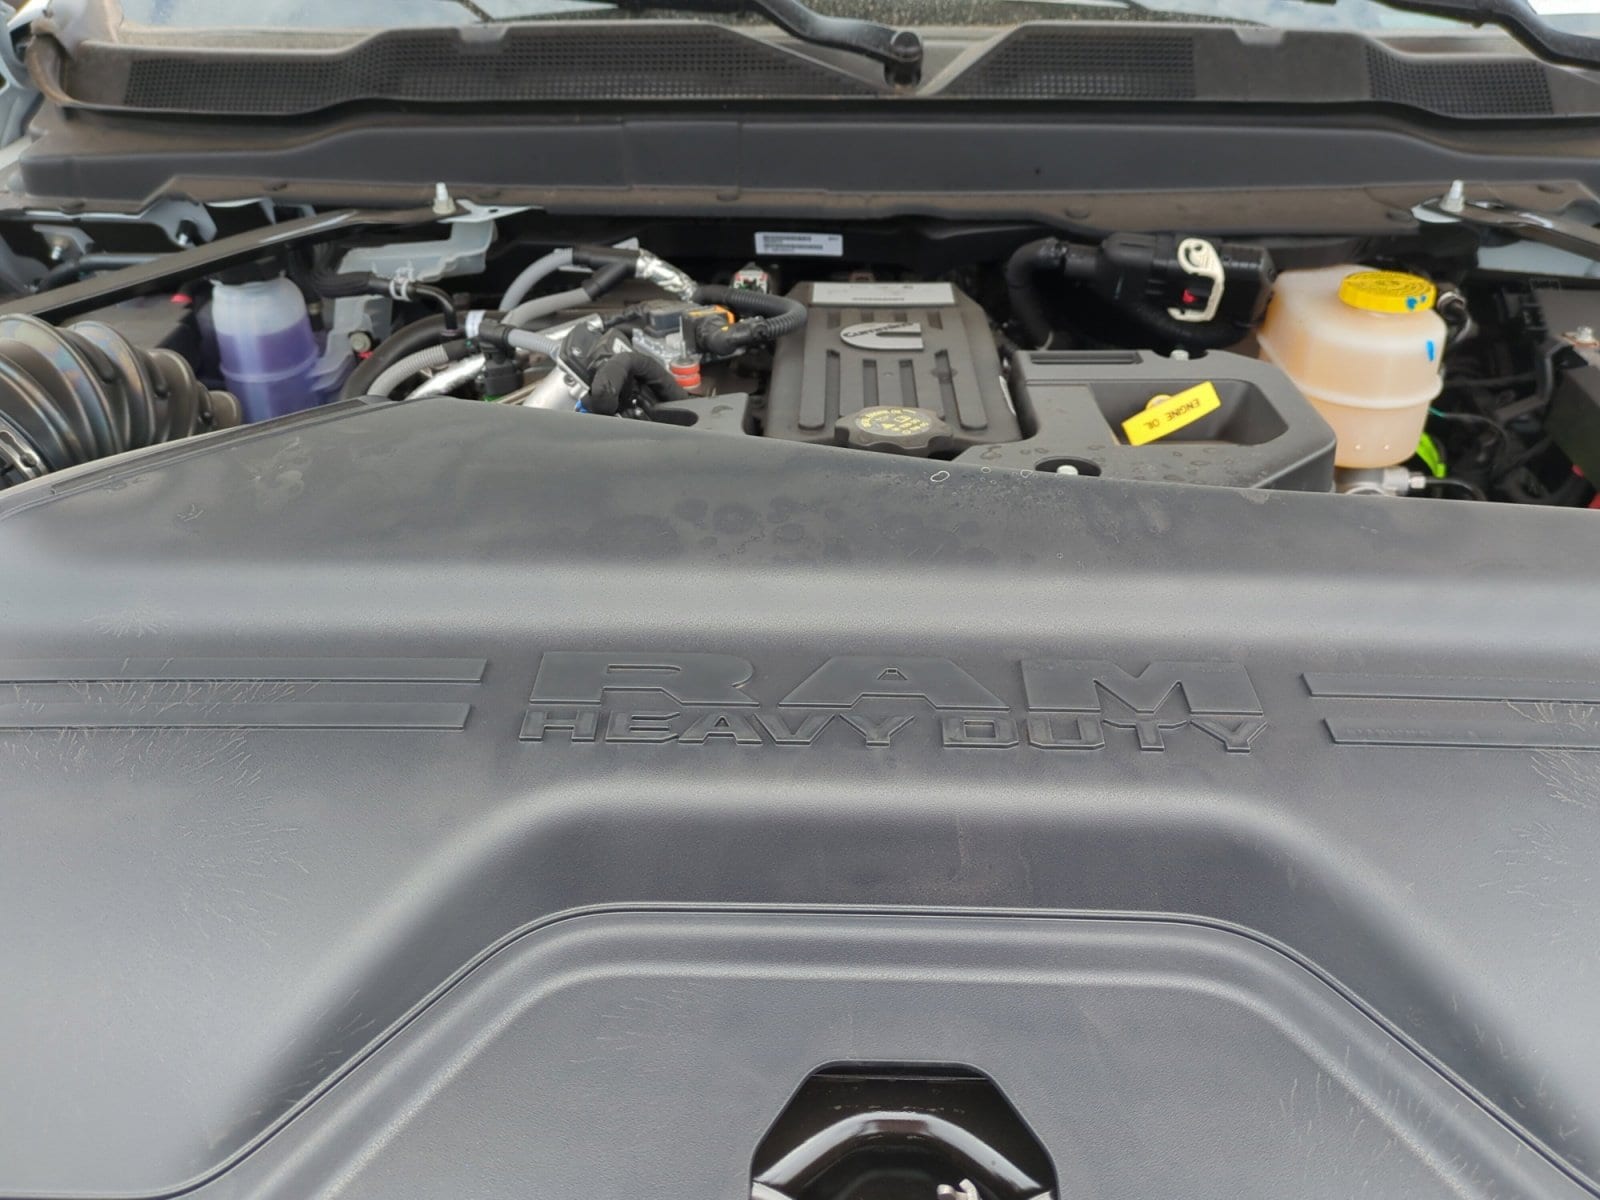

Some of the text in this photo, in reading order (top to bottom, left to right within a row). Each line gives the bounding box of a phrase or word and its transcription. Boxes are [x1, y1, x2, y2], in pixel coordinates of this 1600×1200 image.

[1143, 398, 1200, 430] ENGINE OIL
[528, 651, 1265, 716] RAM
[518, 708, 1268, 753] HEAVY DUTY
